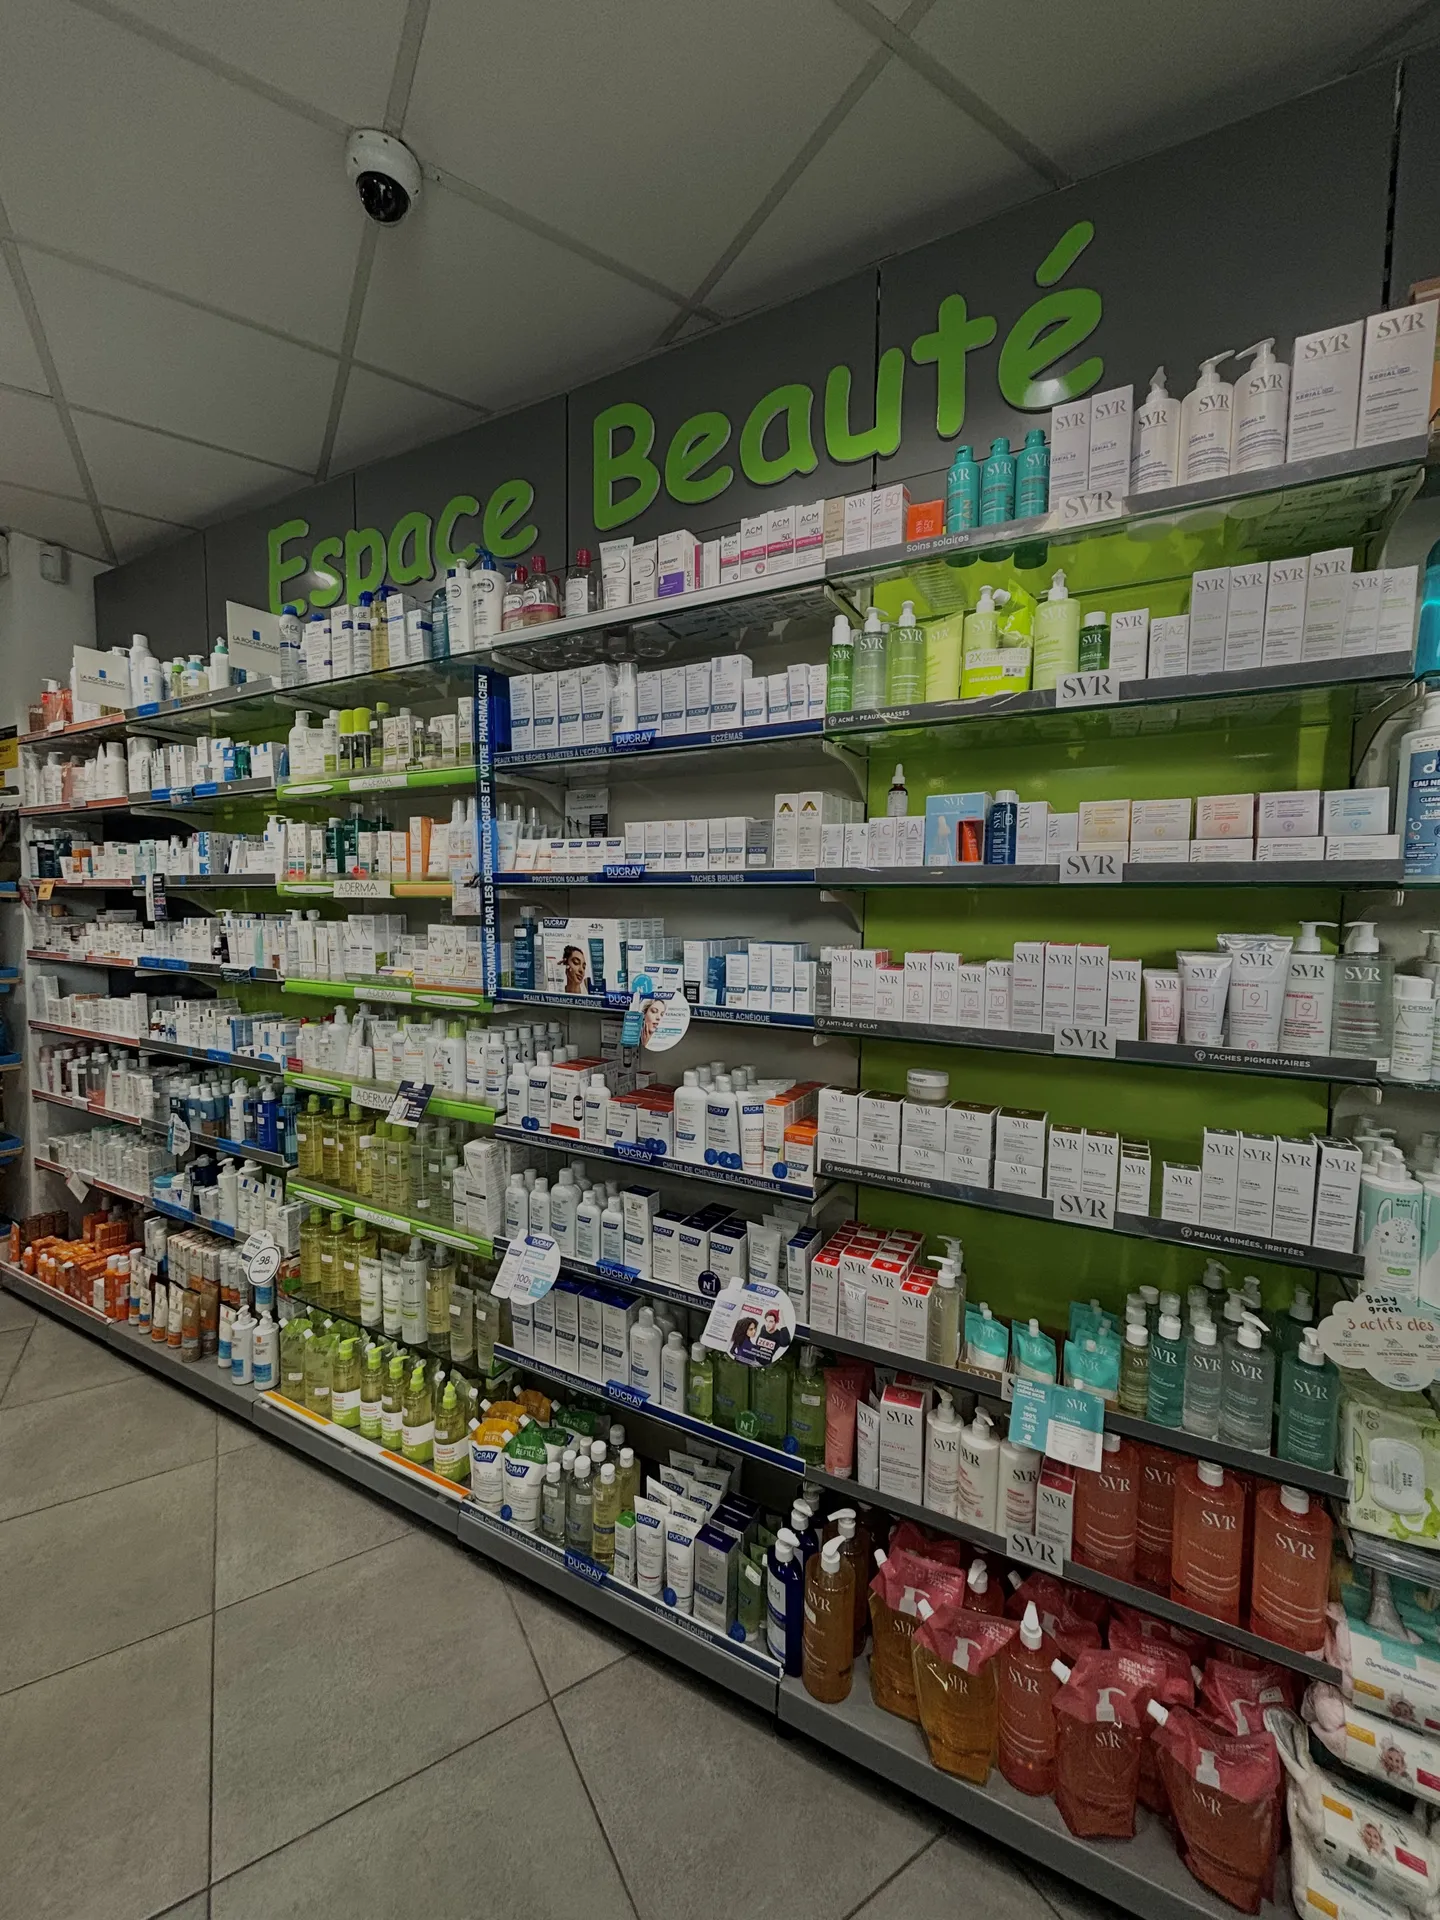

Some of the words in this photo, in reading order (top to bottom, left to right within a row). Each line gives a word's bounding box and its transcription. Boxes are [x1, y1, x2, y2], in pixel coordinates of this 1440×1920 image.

[1377, 311, 1426, 340] SVR
[1305, 332, 1350, 360] SVR
[1250, 373, 1284, 394] SVR
[1095, 400, 1127, 420] SVR
[1199, 394, 1229, 412] SVR
[267, 480, 538, 617] Espace
[593, 220, 1104, 531] Beauté
[1055, 412, 1086, 430] SVR
[1138, 410, 1168, 430] SVR
[1064, 490, 1115, 519] SVR
[772, 518, 789, 528] ACM
[801, 512, 818, 523] ACM
[745, 525, 763, 536] ACM
[724, 539, 737, 548] ACM
[906, 541, 931, 553] Soins
[932, 534, 969, 549] solaires
[1272, 567, 1304, 584] SVR
[1313, 560, 1345, 577] SVR
[1196, 578, 1225, 593] SVR
[1232, 572, 1263, 588] SVR
[1352, 576, 1379, 590] SVR
[1116, 615, 1143, 629] SVR
[899, 629, 924, 642] SVR
[1082, 634, 1102, 645] SVR
[1154, 624, 1163, 643] SVR
[860, 638, 883, 650] SVR
[1062, 675, 1112, 699] SVR
[477, 674, 488, 743] PHARMACIEN
[838, 715, 854, 724] ACNÉ
[859, 713, 880, 721] PEAUX
[882, 710, 910, 719] GRASSES
[616, 732, 652, 745] DUCRAY
[711, 732, 743, 743] ECZÉMAS
[479, 743, 490, 777] VOTRE
[494, 757, 510, 765] PEAUX
[511, 755, 525, 763] TRÈS
[526, 752, 546, 762] SÈCHES
[362, 777, 392, 787] A-DERMA
[481, 780, 490, 794] ET
[1133, 806, 1143, 825] SVR
[1202, 804, 1212, 821] SVR
[1265, 801, 1275, 819] SVR
[1330, 799, 1340, 816] SVR
[1020, 805, 1031, 829] SVR
[1084, 808, 1093, 825] SVR
[481, 795, 493, 883] DERMATOLOGUES
[606, 866, 642, 876] DUCRAY
[1066, 855, 1116, 875] SVR
[690, 874, 716, 882] TACHES
[717, 874, 744, 882] BRUNES
[339, 883, 378, 892] A-DERMA
[484, 884, 494, 903] LES
[485, 904, 495, 923] PAR
[544, 919, 567, 927] DUCRAY
[487, 924, 498, 998] RECOMMANDÉ
[853, 959, 872, 969] SVR
[366, 990, 396, 999] A-DERMA
[540, 994, 544, 1002] À
[545, 996, 573, 1004] TENDANCE
[575, 998, 602, 1007] ACNÉIQUE
[693, 1008, 698, 1016] À
[700, 1010, 734, 1019] TENDANCE
[736, 1013, 770, 1022] ACNÉIQUE
[1401, 1004, 1433, 1012] A-DERMA
[826, 1019, 853, 1028] ANTI-ÂGE
[859, 1022, 878, 1030] ÉCLAT
[1060, 1028, 1108, 1049] SVR
[1208, 1053, 1241, 1063] TACHES
[1244, 1056, 1311, 1068] PIGMENTAIRES
[357, 1090, 394, 1105] A-DERMA
[708, 1106, 727, 1115] DUCRAY
[618, 1146, 653, 1160] DUCRAY
[663, 1162, 682, 1171] CHUTE
[684, 1165, 693, 1173] DE
[694, 1168, 725, 1179] CHEVEUX
[725, 1173, 781, 1191] RÉACTIONNELLE
[834, 1166, 863, 1176] ROUGEURS
[867, 1172, 886, 1180] PEAUX
[887, 1175, 931, 1189] INTOLÉRANTES
[1060, 1194, 1108, 1220] SVR
[654, 1226, 674, 1235] DUCRAY
[532, 1238, 553, 1248] DUCRAY
[680, 1234, 701, 1245] DUCRAY
[711, 1243, 733, 1252] DUCRAY
[1193, 1230, 1221, 1241] PEAUX
[1223, 1235, 1263, 1249] ABIMÉES,
[1264, 1243, 1305, 1257] IRRITÉES
[600, 1267, 634, 1282] DUCRAY
[756, 1286, 778, 1296] DUCRAY
[1366, 1295, 1397, 1305] Baby
[743, 1305, 762, 1314] NOUVEAU
[1368, 1305, 1402, 1315] green
[1347, 1318, 1356, 1330] 3
[1360, 1317, 1403, 1332] actifs
[1408, 1317, 1434, 1331] clés
[758, 1339, 774, 1348] ZERO
[517, 1356, 533, 1367] PEAUX
[1230, 1359, 1264, 1381] SVR
[609, 1386, 643, 1408] DUCRAY
[1294, 1379, 1328, 1400] SVR
[515, 1449, 535, 1458] REFILL
[663, 1481, 683, 1494] DUCRAY
[1099, 1474, 1131, 1492] SVR
[1042, 1491, 1066, 1509] SVR
[637, 1515, 659, 1527] DUCRAY
[1202, 1511, 1236, 1531] SVR
[668, 1532, 692, 1545] DUCRAY
[1275, 1532, 1316, 1560] SVR
[1011, 1533, 1056, 1565] SVR
[568, 1558, 602, 1582] DUCRAY
[807, 1588, 832, 1613] SVR
[655, 1607, 676, 1623] USAGE
[678, 1619, 714, 1643] FRÉQUENT
[947, 1673, 969, 1695] SVR
[1007, 1665, 1040, 1695] SVR
[1096, 1729, 1121, 1749] SVR
[1192, 1788, 1222, 1817] SVR
